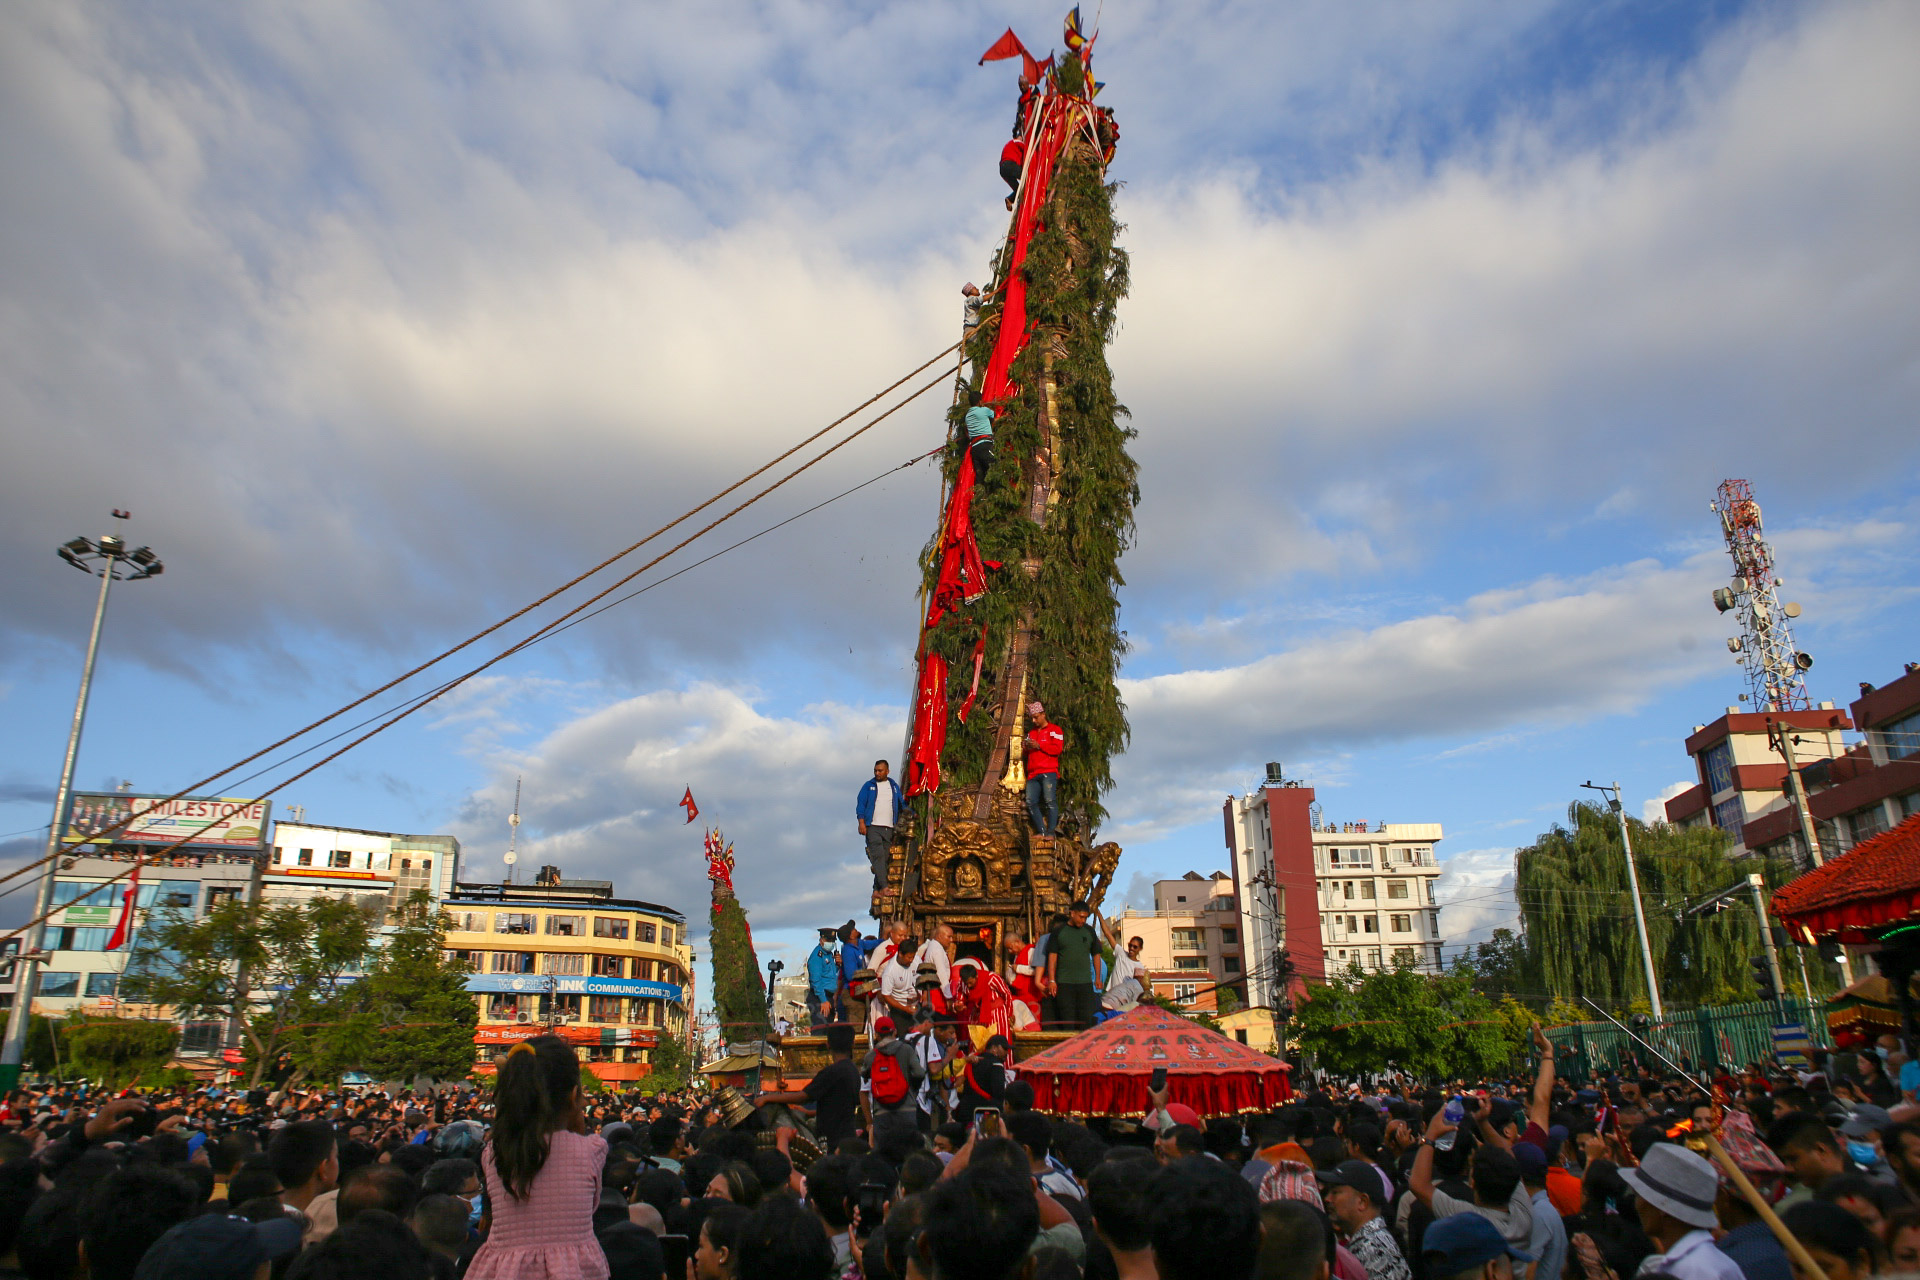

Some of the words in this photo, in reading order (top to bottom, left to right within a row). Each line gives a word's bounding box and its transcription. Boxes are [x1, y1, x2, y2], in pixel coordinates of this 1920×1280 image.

[149, 800, 263, 819] MILESTONE
[588, 983, 662, 997] COMMUNICATIONS
[479, 1030, 499, 1038] The
